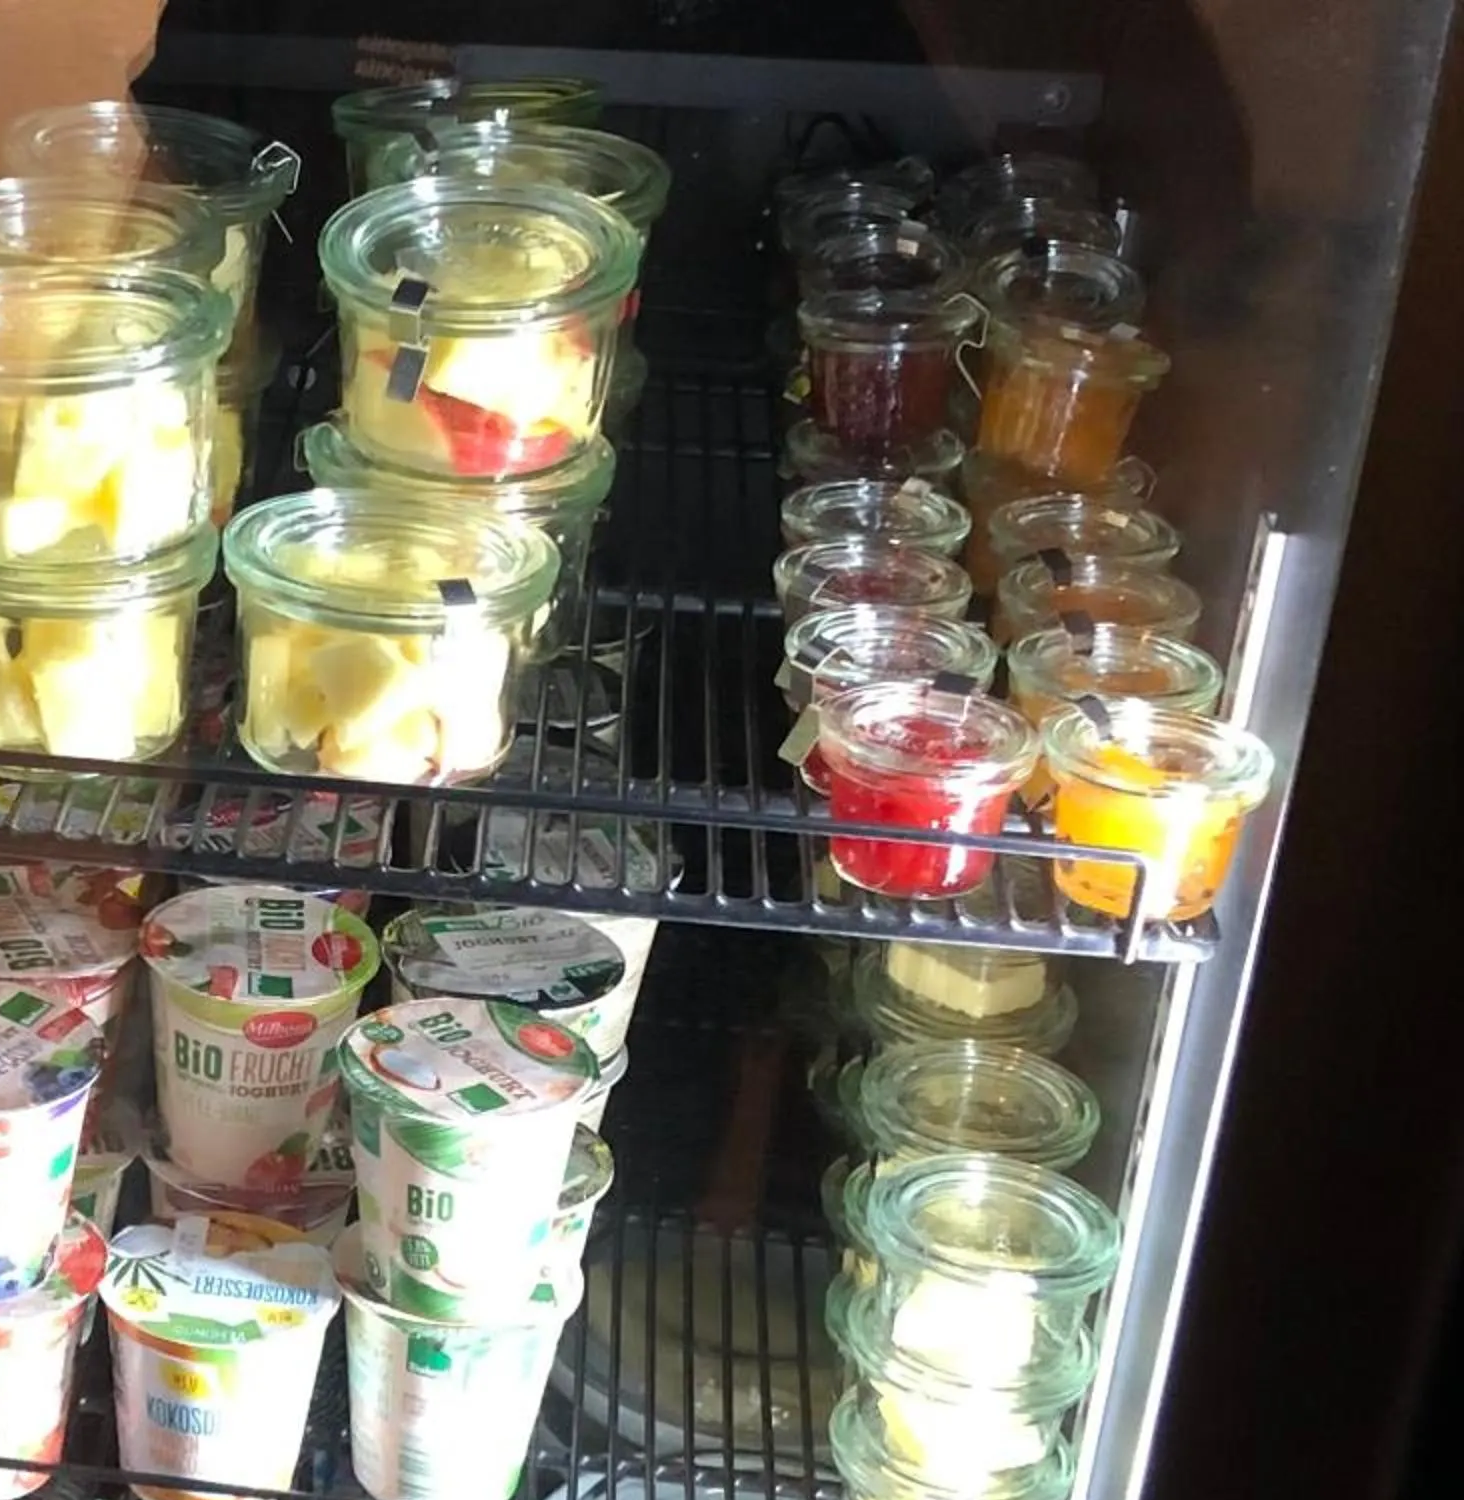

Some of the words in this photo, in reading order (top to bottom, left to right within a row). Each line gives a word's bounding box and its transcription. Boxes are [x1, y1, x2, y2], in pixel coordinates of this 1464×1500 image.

[229, 1049, 314, 1084] FRUCHT
[229, 1081, 310, 1099] JOGHURT
[192, 1274, 320, 1306] KOKOSDESSERT
